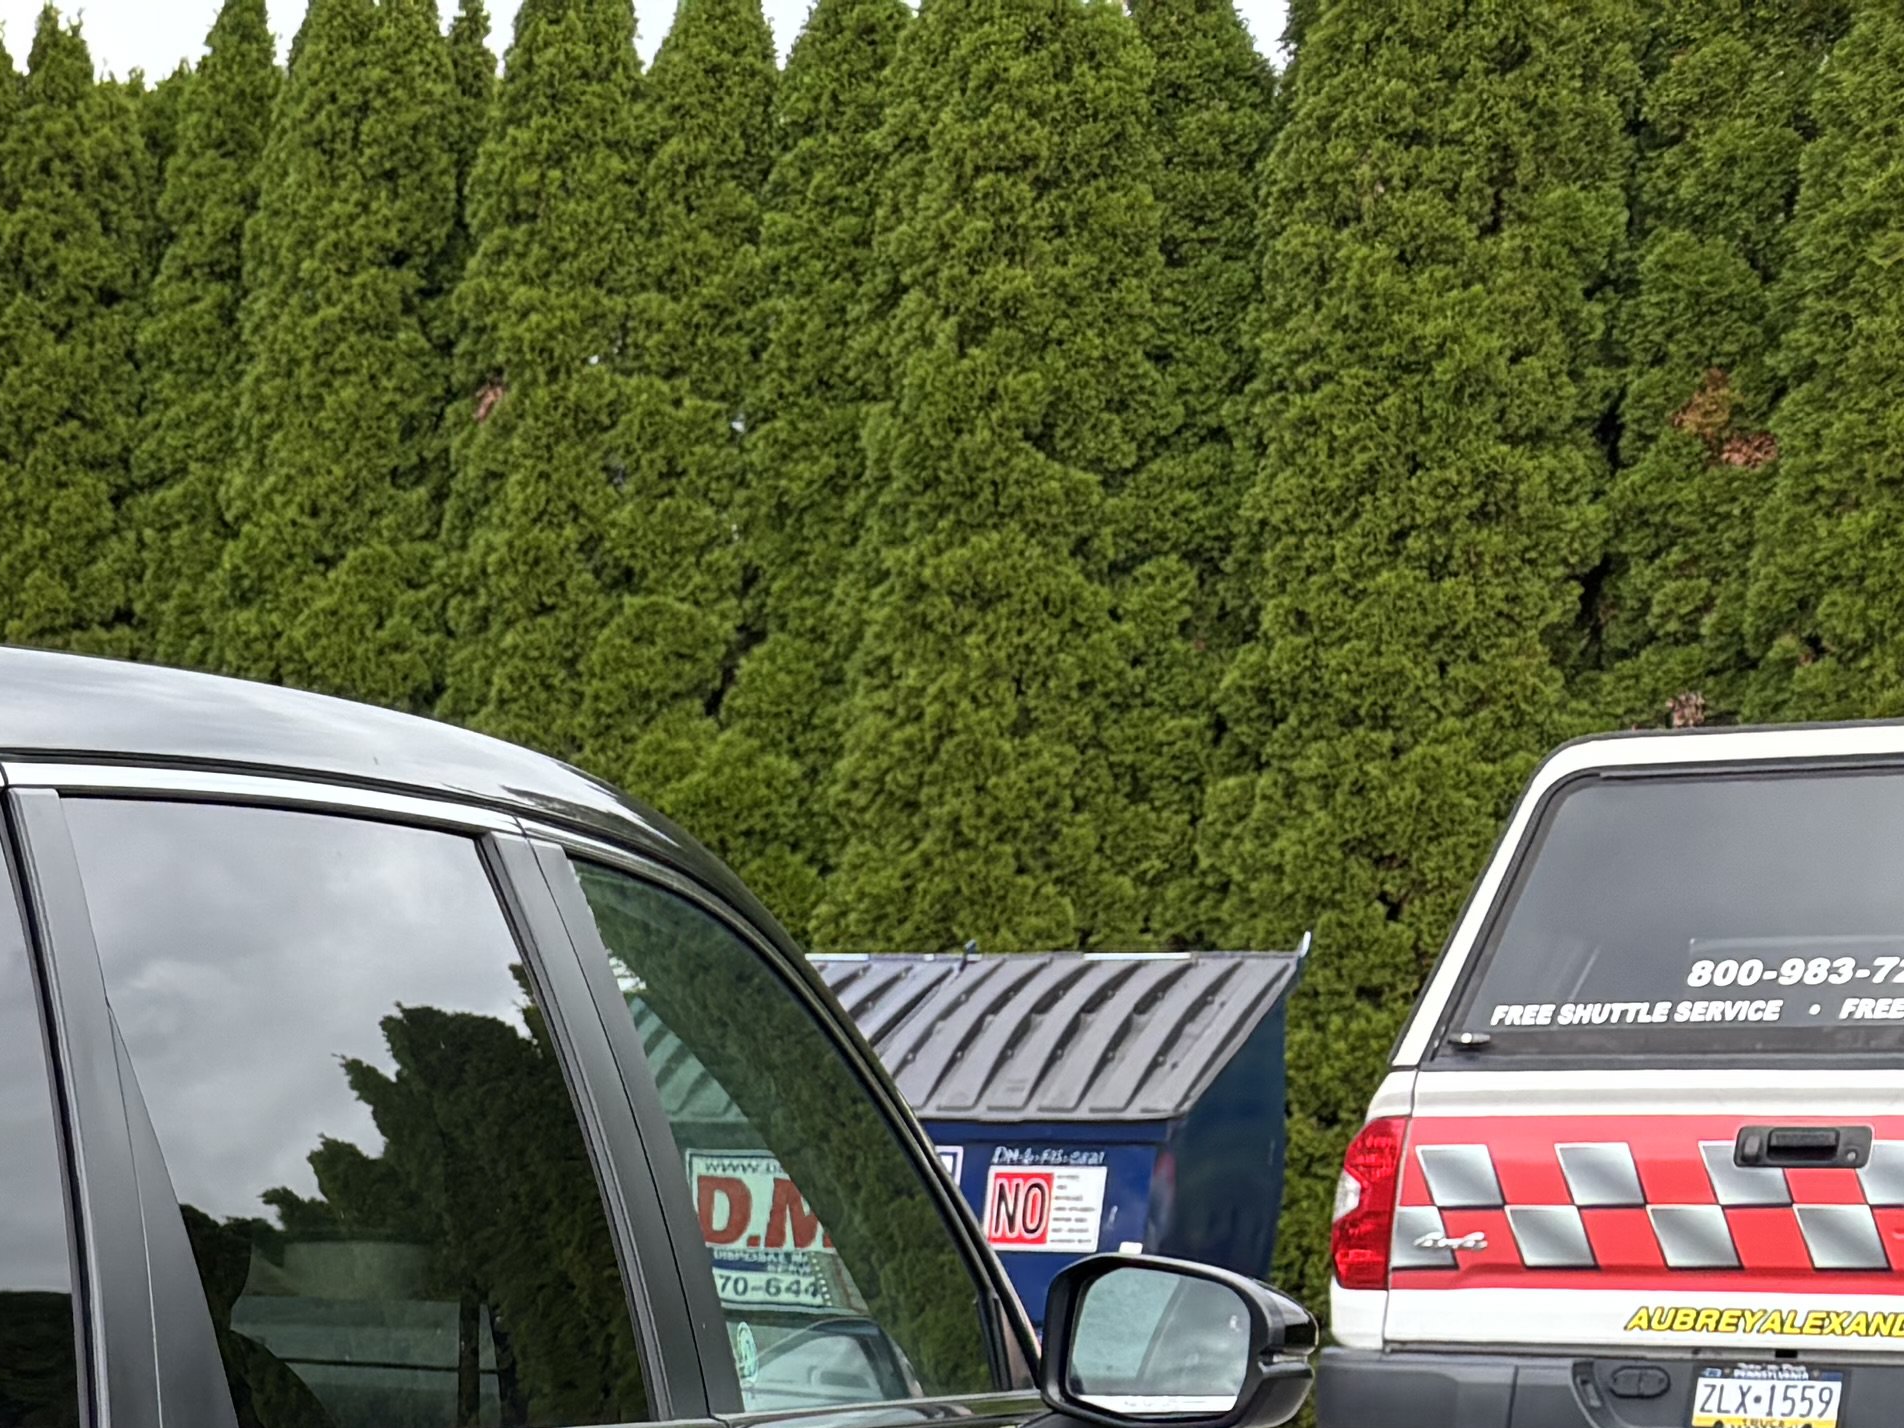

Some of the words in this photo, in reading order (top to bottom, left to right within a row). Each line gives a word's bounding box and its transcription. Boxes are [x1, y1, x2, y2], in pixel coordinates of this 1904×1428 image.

[1490, 1004, 1556, 1026] FREE
[1557, 1001, 1672, 1025] SHUTTLE
[1673, 999, 1784, 1023] SERVICE
[1838, 997, 1904, 1020] FREE
[994, 1179, 1049, 1237] NO
